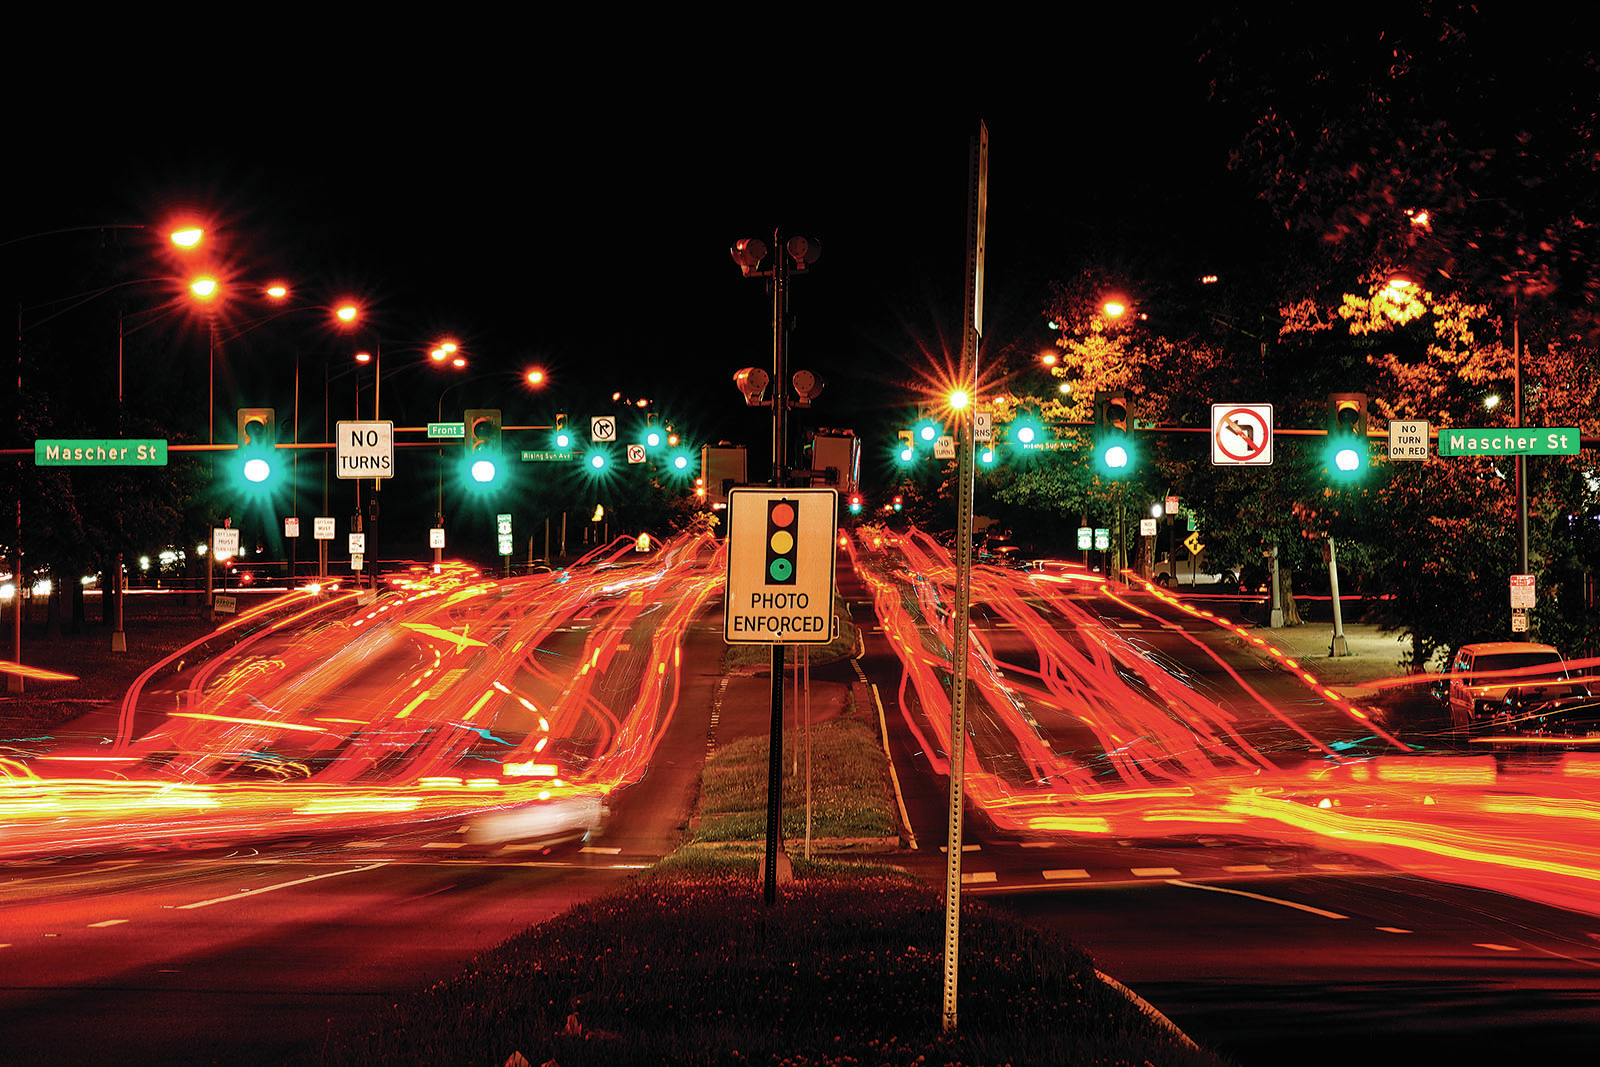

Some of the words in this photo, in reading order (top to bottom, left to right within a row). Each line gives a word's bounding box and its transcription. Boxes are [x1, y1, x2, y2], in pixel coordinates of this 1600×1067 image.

[432, 426, 457, 435] Front
[975, 429, 990, 437] RNS
[1401, 425, 1417, 433] NO
[351, 430, 379, 447] NO
[1398, 436, 1421, 444] TURN
[1450, 434, 1537, 450] Mascher
[1547, 433, 1568, 449] St
[46, 444, 128, 461] Mascher
[136, 444, 157, 461] St
[1392, 447, 1404, 455] ON
[1408, 447, 1426, 455] RED
[340, 455, 391, 470] TURNS
[751, 593, 809, 609] PHOTO
[734, 616, 824, 632] ENFORCED
